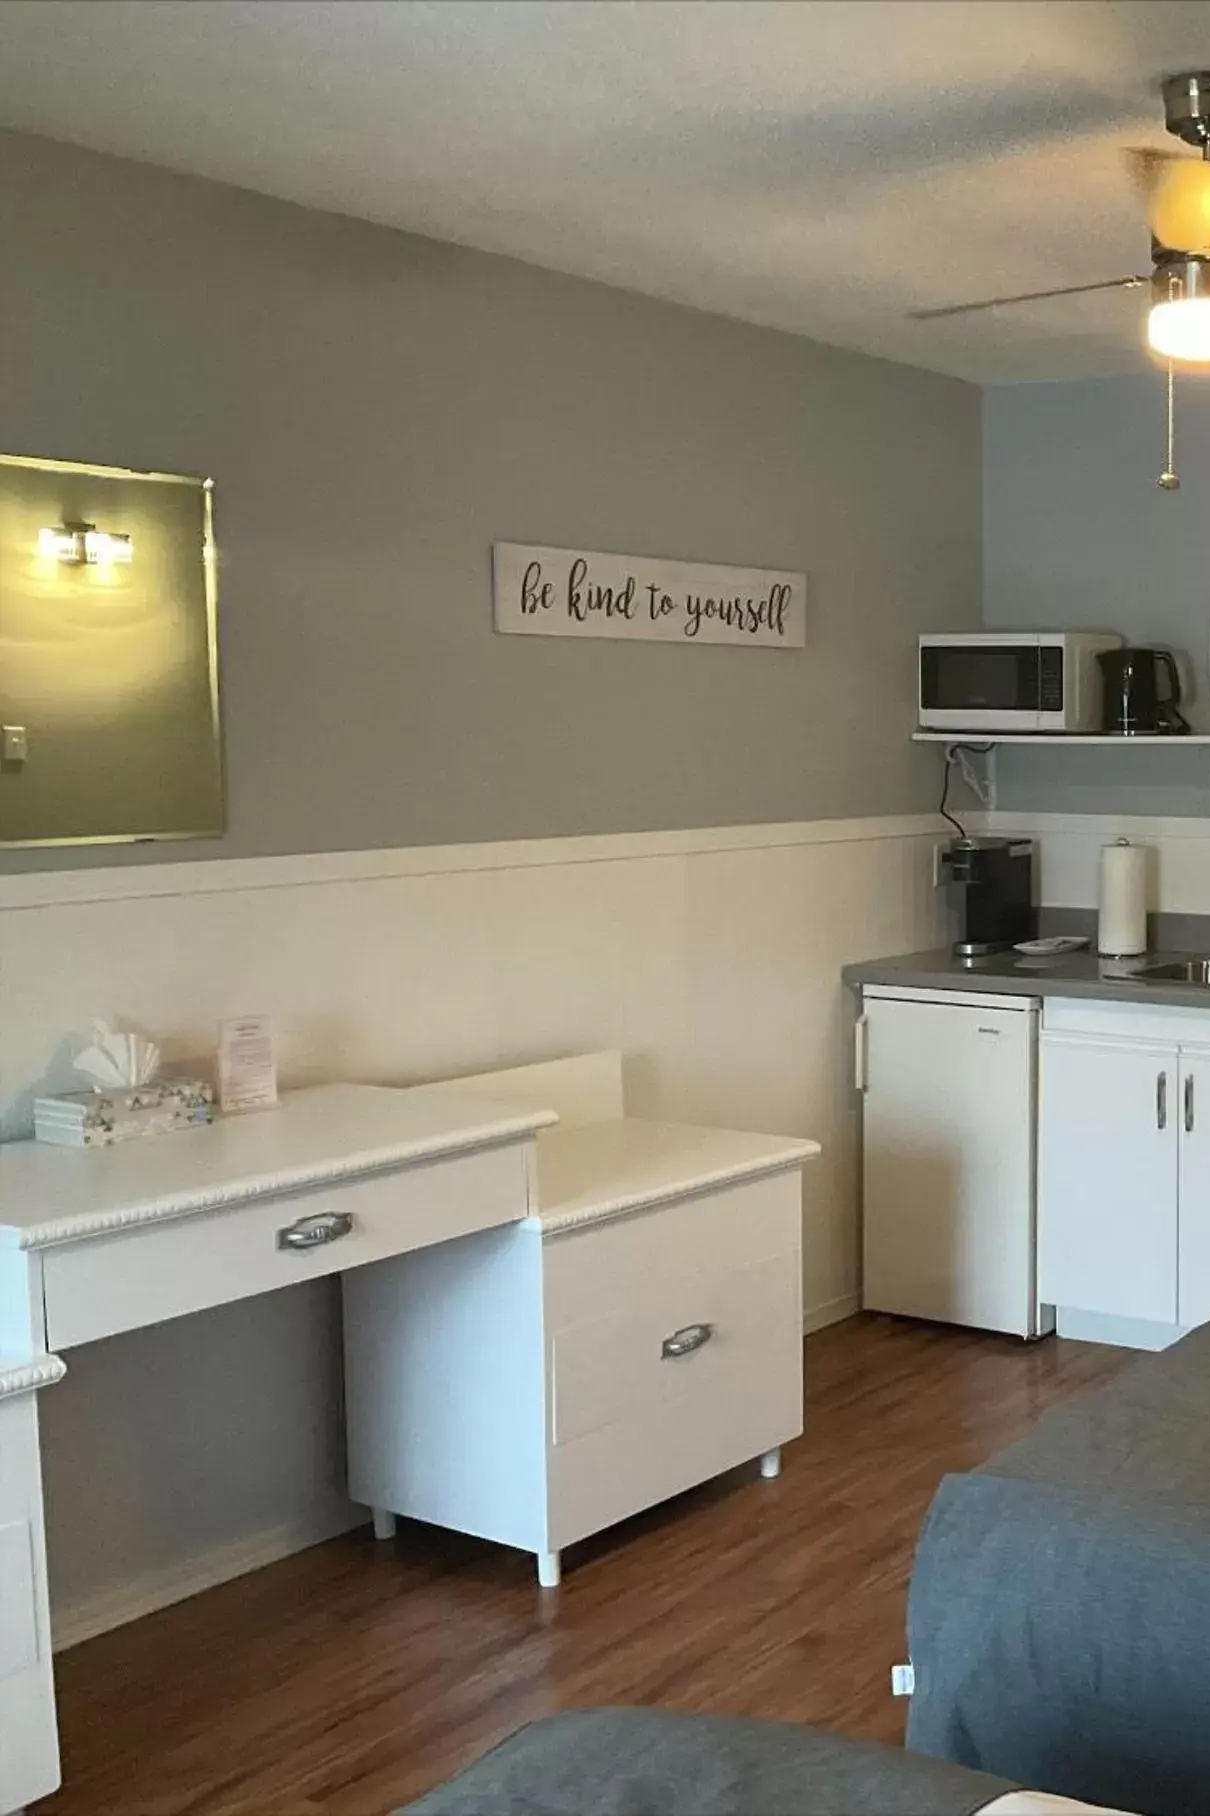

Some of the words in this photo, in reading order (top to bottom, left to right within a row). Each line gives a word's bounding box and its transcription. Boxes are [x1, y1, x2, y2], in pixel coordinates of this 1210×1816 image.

[521, 561, 555, 614] be
[567, 558, 636, 621] kind
[645, 582, 678, 620] to
[684, 583, 792, 637] yourself
